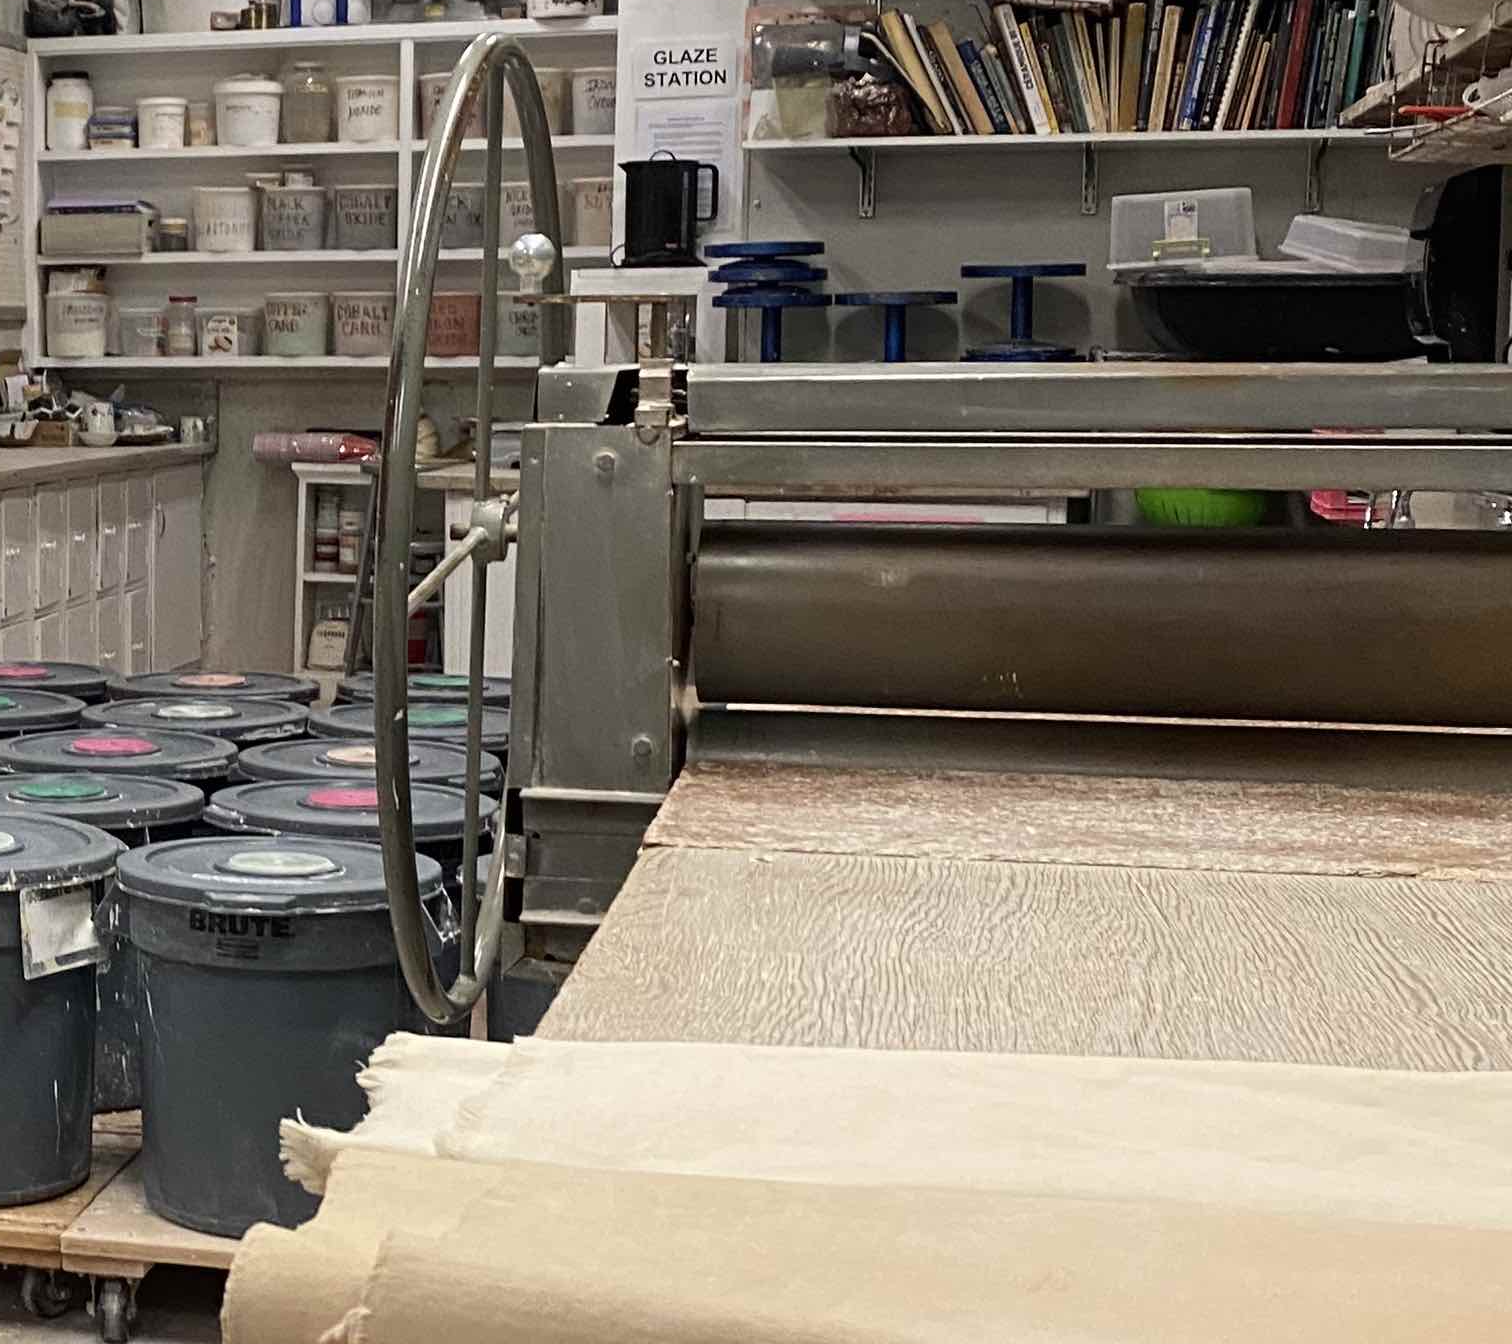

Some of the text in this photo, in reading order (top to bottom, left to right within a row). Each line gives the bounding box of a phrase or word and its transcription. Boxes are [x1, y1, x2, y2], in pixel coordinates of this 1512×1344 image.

[653, 48, 719, 65] GLAZE
[643, 69, 728, 88] STATION
[189, 908, 295, 938] BRUTE
